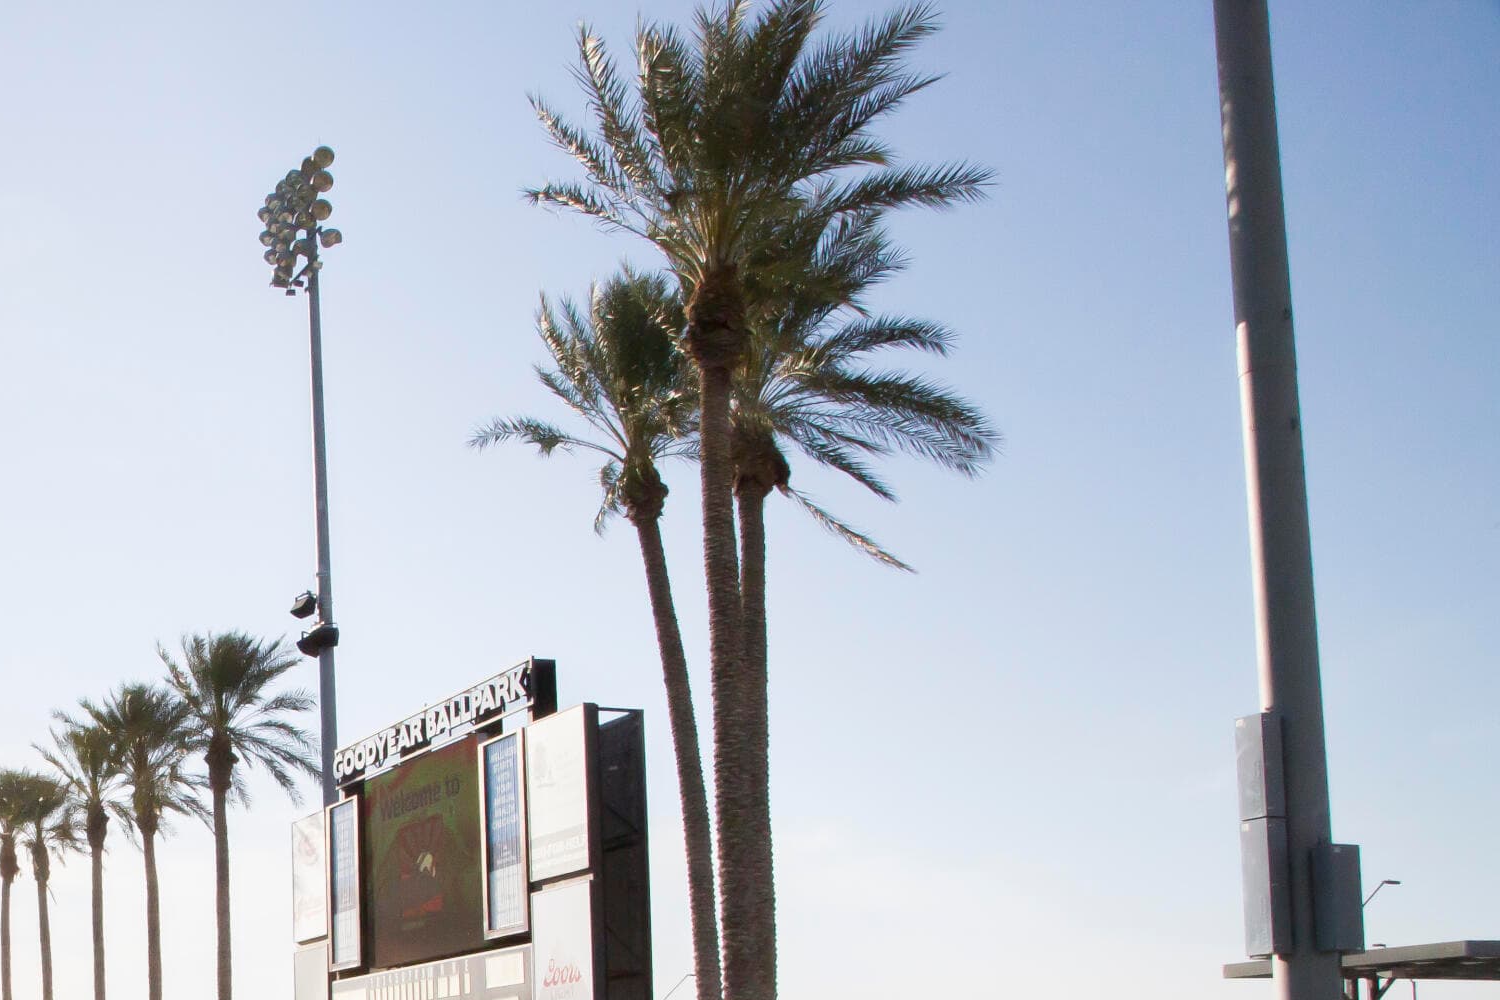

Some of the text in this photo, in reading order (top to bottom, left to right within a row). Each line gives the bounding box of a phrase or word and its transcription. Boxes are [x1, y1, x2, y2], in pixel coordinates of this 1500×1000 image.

[333, 664, 528, 780] GOODYEAR BALLPARK
[380, 773, 460, 821] Welcome to
[543, 958, 582, 988] Coors
